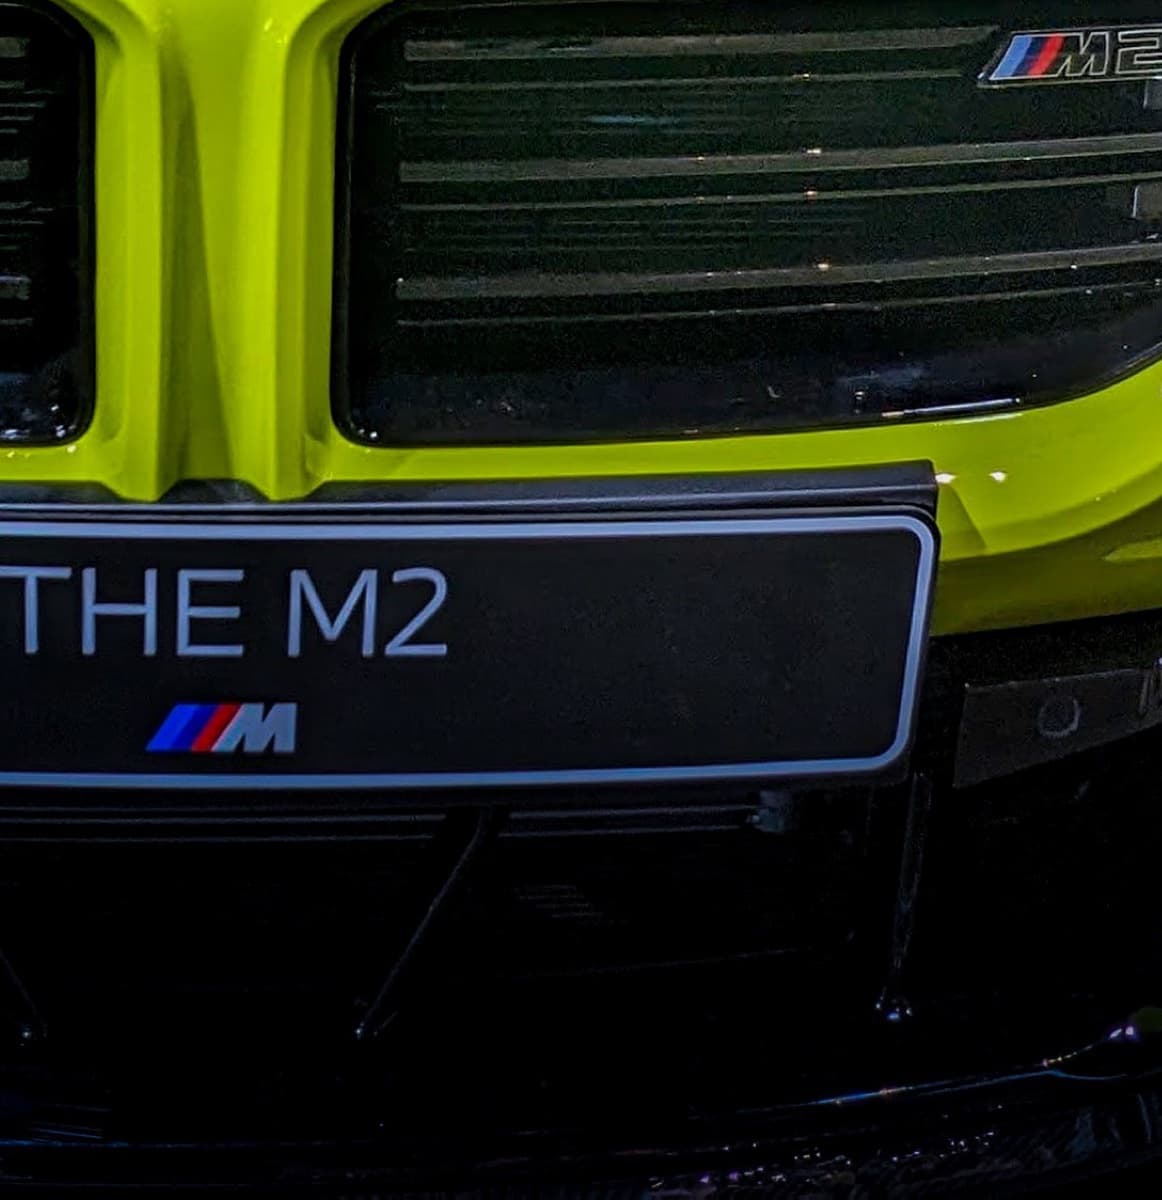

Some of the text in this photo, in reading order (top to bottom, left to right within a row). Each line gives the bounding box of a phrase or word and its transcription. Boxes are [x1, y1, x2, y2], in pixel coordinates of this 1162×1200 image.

[0, 565, 447, 657] THE M2
[210, 702, 298, 752] M
